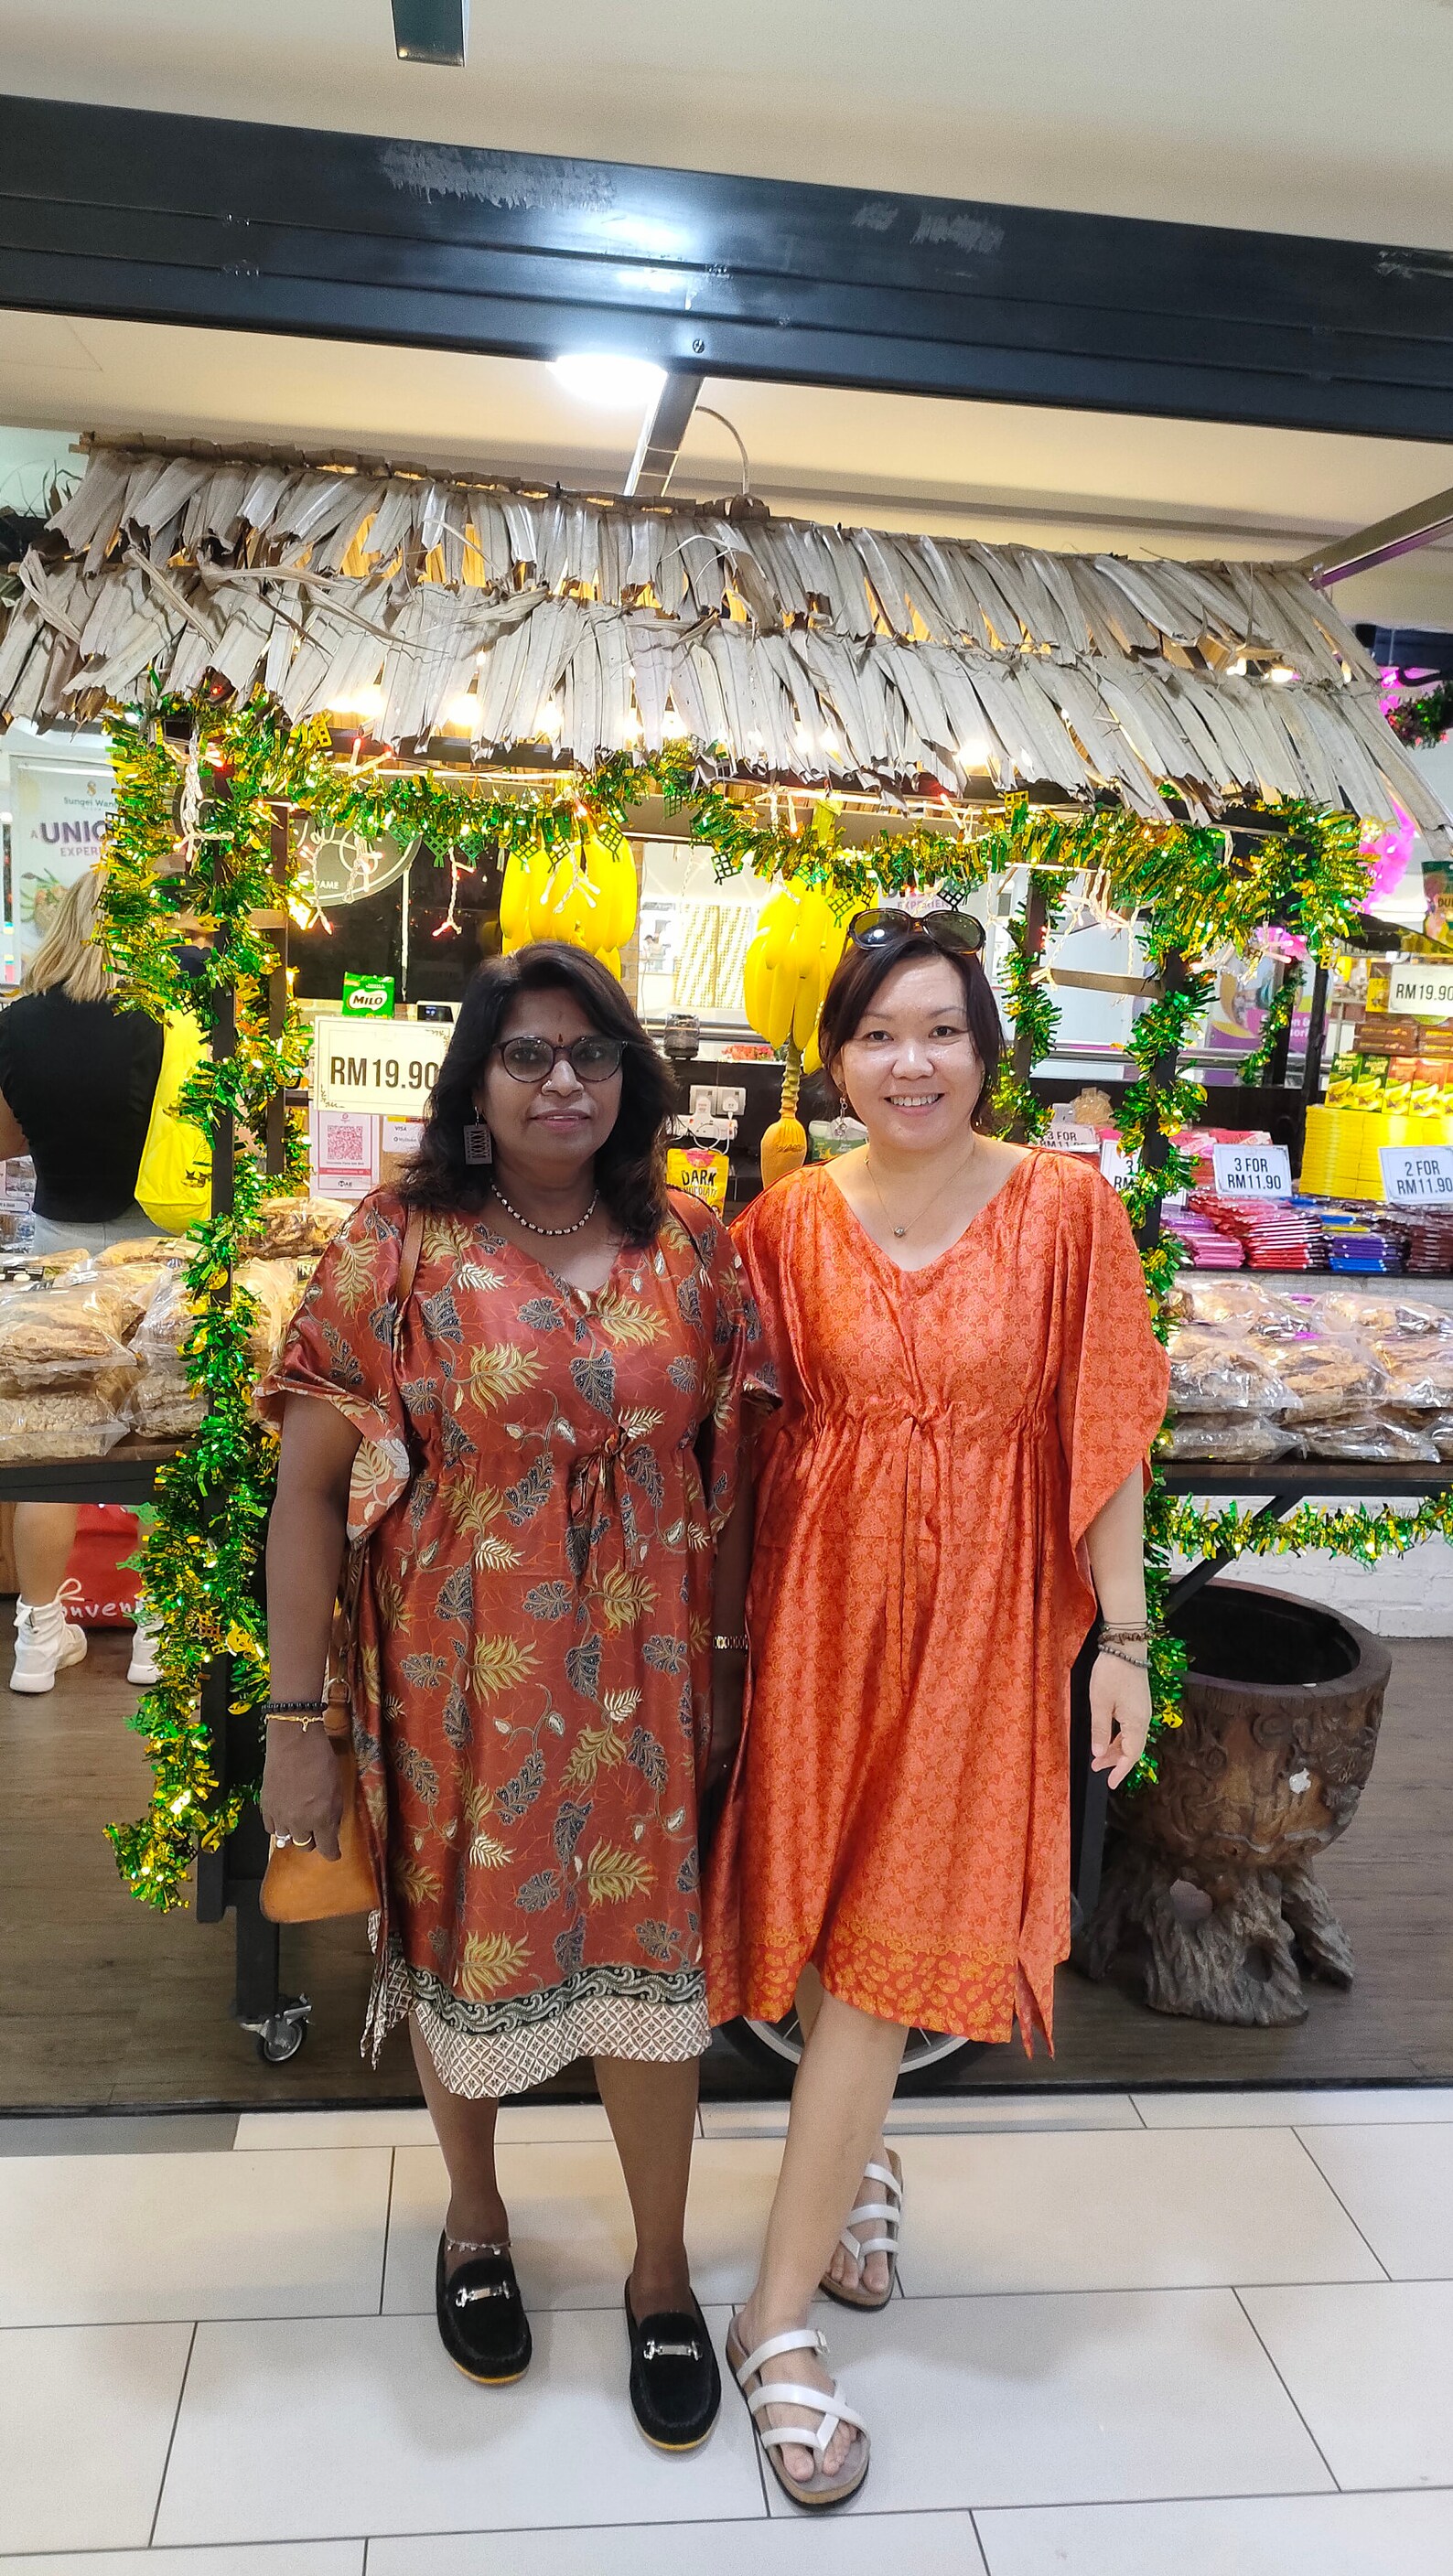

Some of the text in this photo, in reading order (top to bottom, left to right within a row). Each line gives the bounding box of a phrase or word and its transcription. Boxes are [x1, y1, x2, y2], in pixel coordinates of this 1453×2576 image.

[352, 995, 383, 1005] MILO
[330, 1056, 440, 1090] RM19.90
[1047, 1131, 1078, 1142] 3 FOR
[1126, 1160, 1134, 1175] 3
[1233, 1157, 1268, 1173] 3 FOR
[1405, 1160, 1441, 1176] 2 FOR
[681, 1169, 717, 1187] DARK
[1227, 1174, 1282, 1190] RM11.90
[1396, 1176, 1453, 1196] RM11.90
